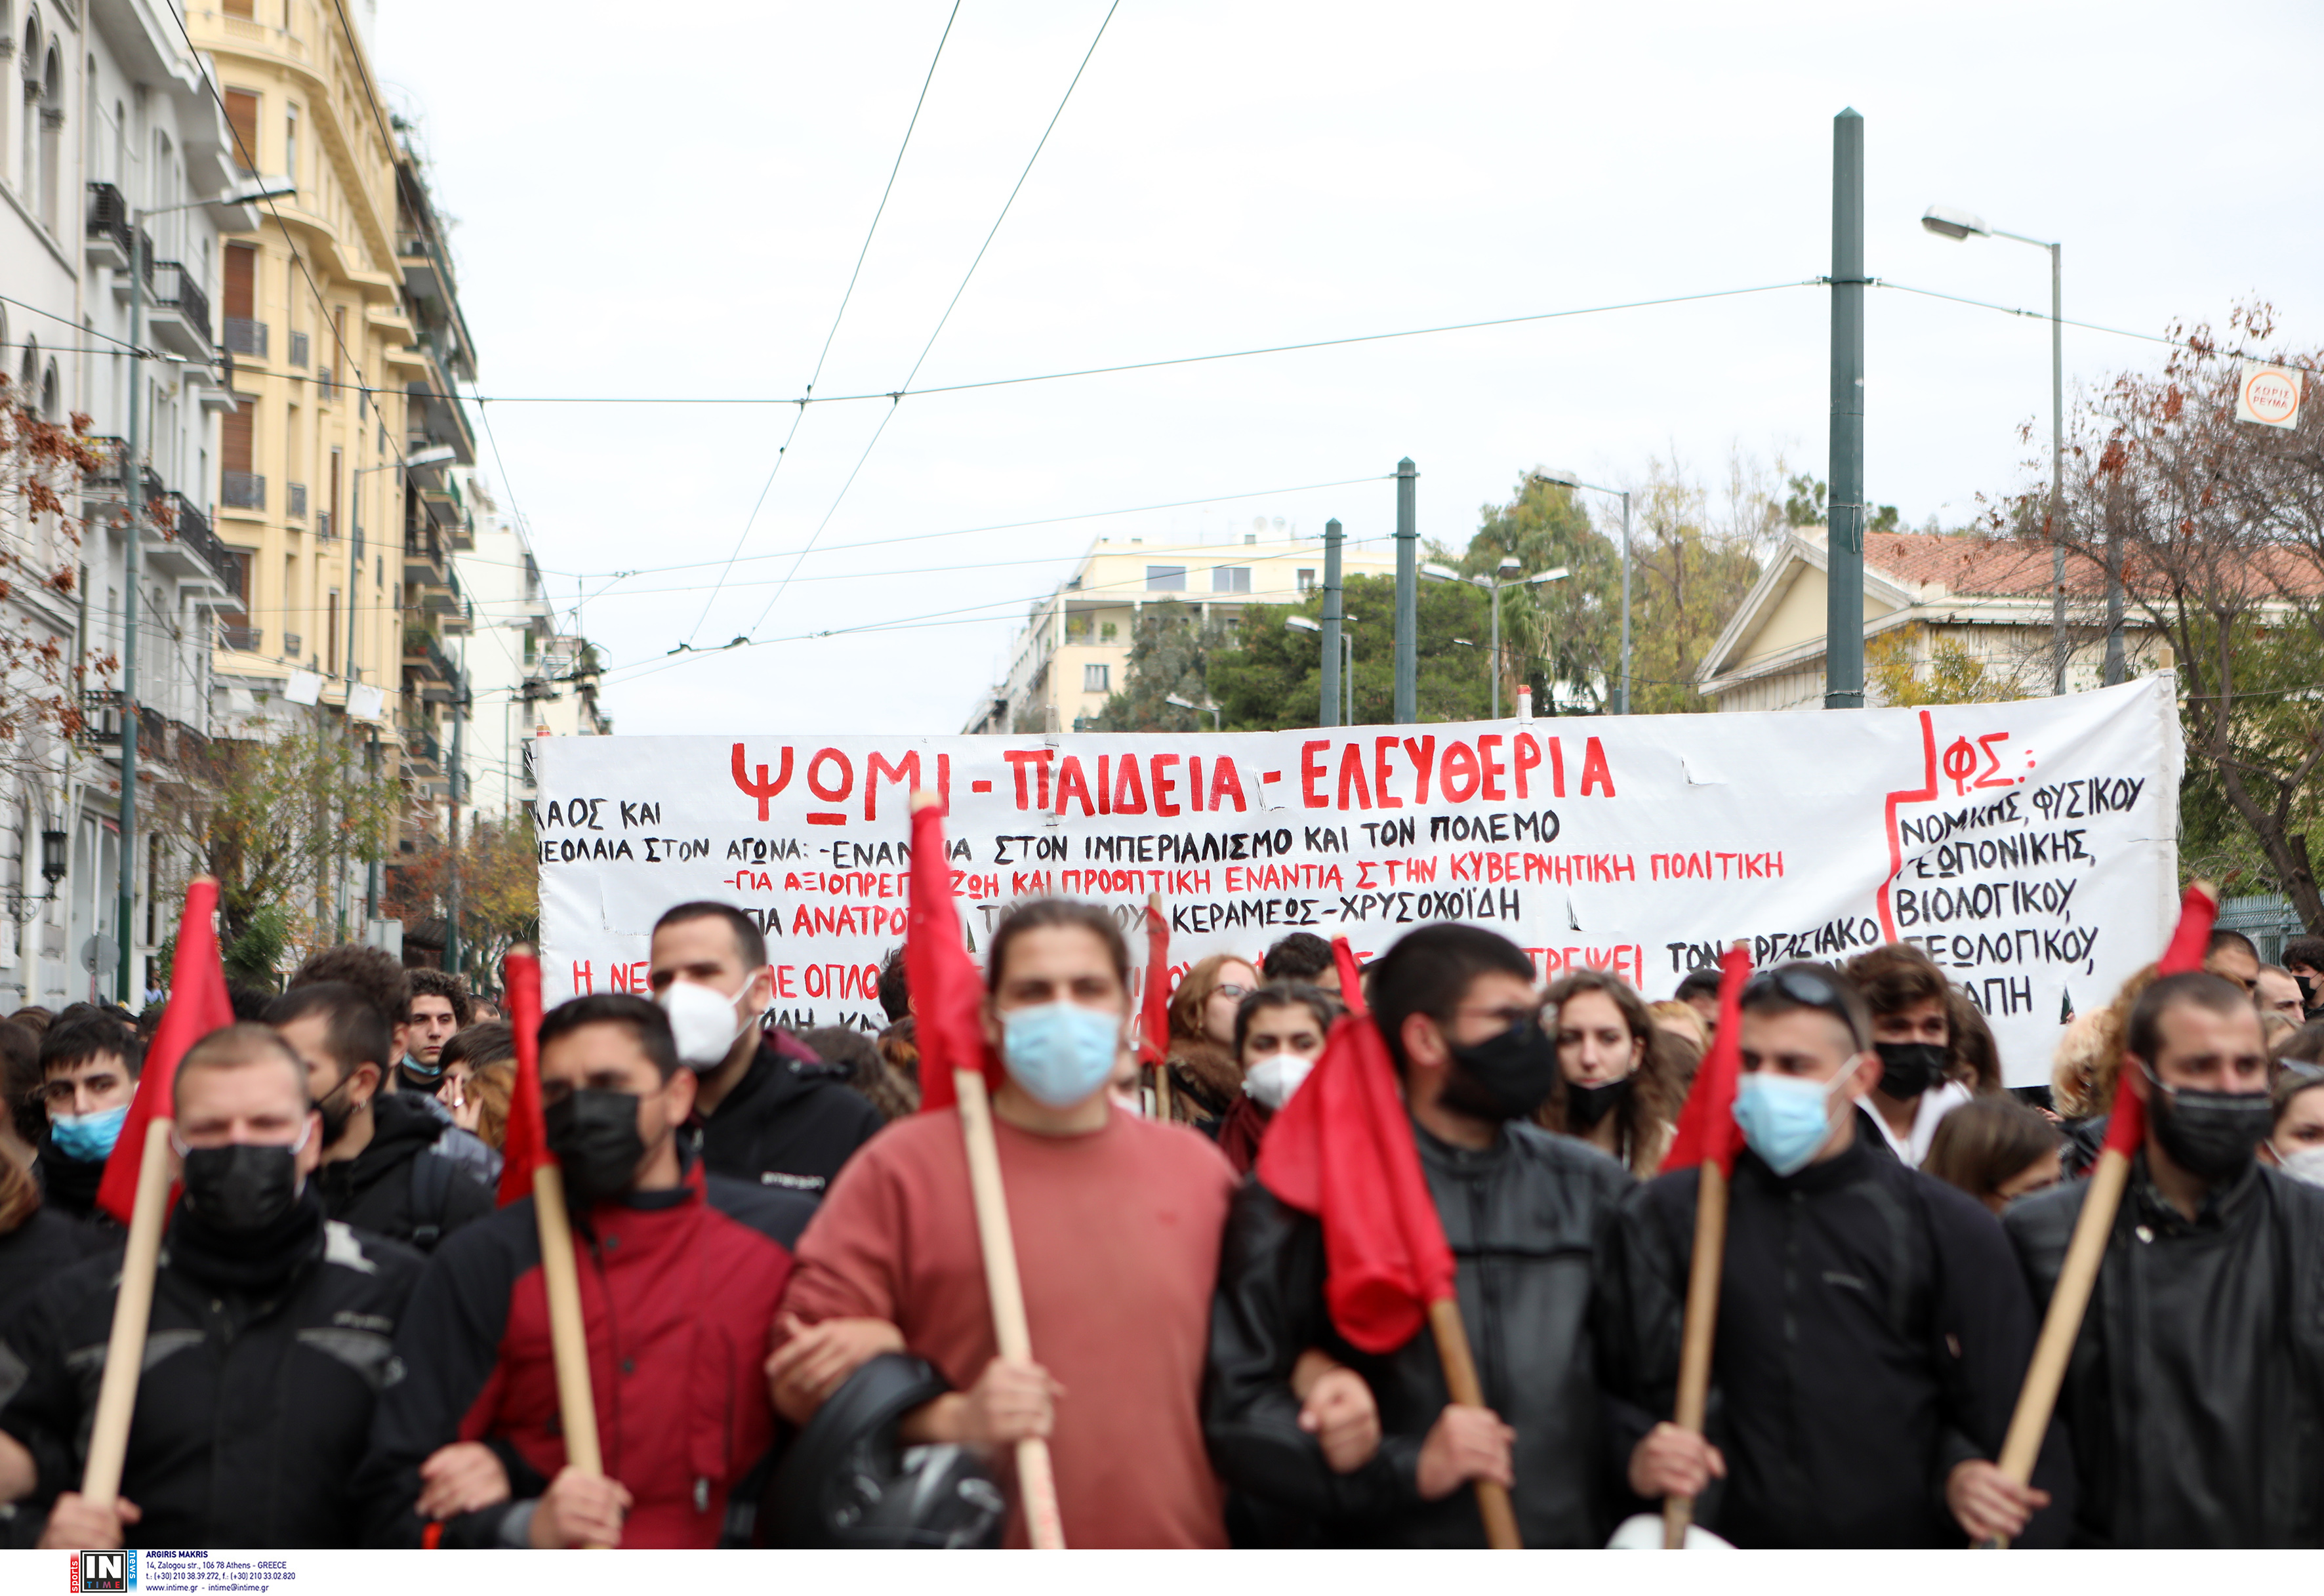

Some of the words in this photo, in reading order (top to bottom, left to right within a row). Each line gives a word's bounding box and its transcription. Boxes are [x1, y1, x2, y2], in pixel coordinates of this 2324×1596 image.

[2253, 396, 2288, 409] ΡΕΥΜΑ
[731, 743, 950, 825] ΨΩΜΙ
[1003, 749, 1247, 818] ΠΑΙΔΕΙΑ
[1301, 732, 1616, 811] ΕΛΕΥΘΕΡΙΑ
[2033, 777, 2144, 820] ΦΥΣΙΚΟΥ
[620, 800, 661, 830] ΚΑΙ
[643, 837, 710, 863] ΣΤΟΝ
[820, 838, 972, 869] -ΕΝΑΝΙΑ
[994, 835, 1068, 865] ΣΤΟΝ
[1085, 829, 1293, 865] ΙΜΠΕΡΙΑΛΙΣΜΟ
[1305, 826, 1349, 853] ΚΑΙ
[1361, 816, 1415, 848] ΤΟΝ
[1430, 809, 1560, 844] ΠΟΛΕΜΟ
[782, 867, 910, 899] ΑΞΙΟΠΡΕΠ
[1012, 869, 1051, 896] ΚΑΙ
[1225, 863, 1345, 893] ΕΝΑΝΤΙΑ
[1356, 855, 1438, 890] ΣΤΗΝ
[1450, 851, 1635, 886] ΚΥΒΕΡΝΗΤΙΚΗ
[1650, 850, 1784, 882] ΠΟΛΙΤΙΚΗ
[791, 903, 910, 938] ΑΝΑΤΡΟ
[1895, 878, 2078, 928] ΒΙΟΛΟΓΙΚΟΥ,
[573, 960, 594, 996] Η
